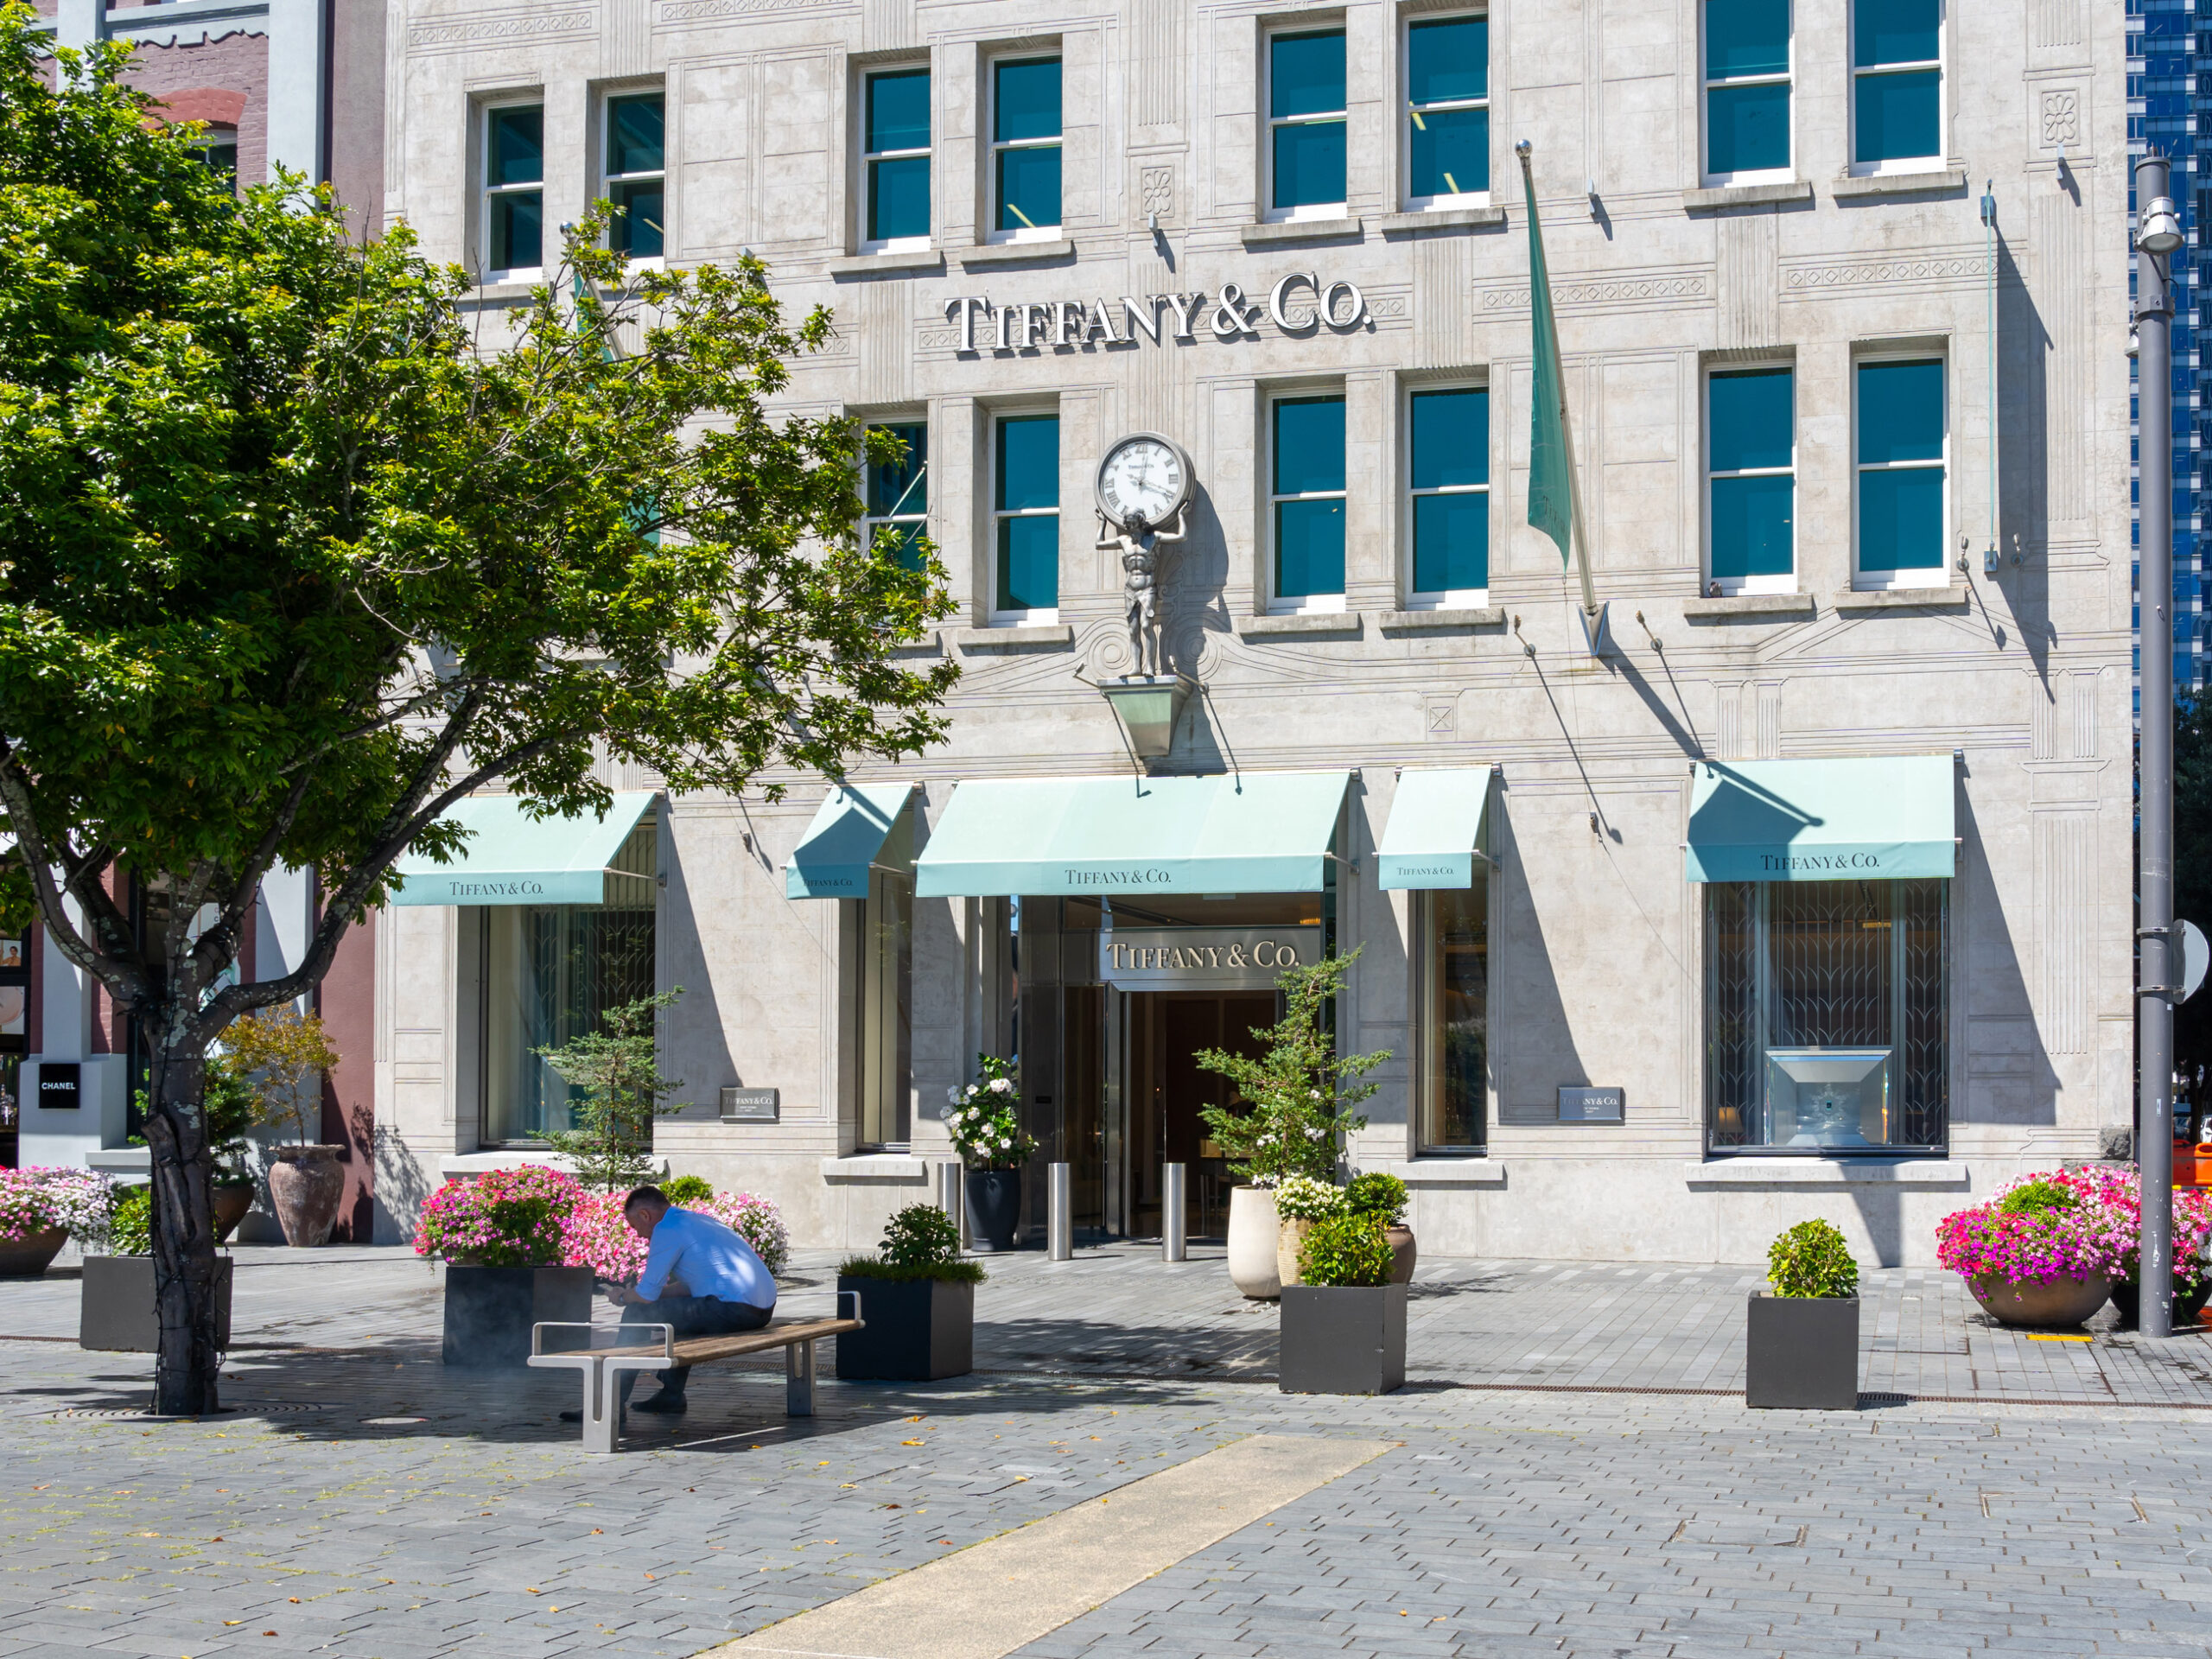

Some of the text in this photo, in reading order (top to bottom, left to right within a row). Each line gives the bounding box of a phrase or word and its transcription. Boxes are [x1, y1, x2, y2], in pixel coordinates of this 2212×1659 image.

[944, 272, 1373, 353] TIFFANY & CO.
[1760, 853, 1880, 870] TIFFANY & CO.
[1065, 868, 1172, 884] TIFFANY & CO.
[1396, 867, 1432, 875] TIFFANY
[449, 880, 543, 895] TIFFANY & CO.
[1106, 940, 1301, 969] TIFFANY & CO.
[1604, 1096, 1618, 1105] CO.
